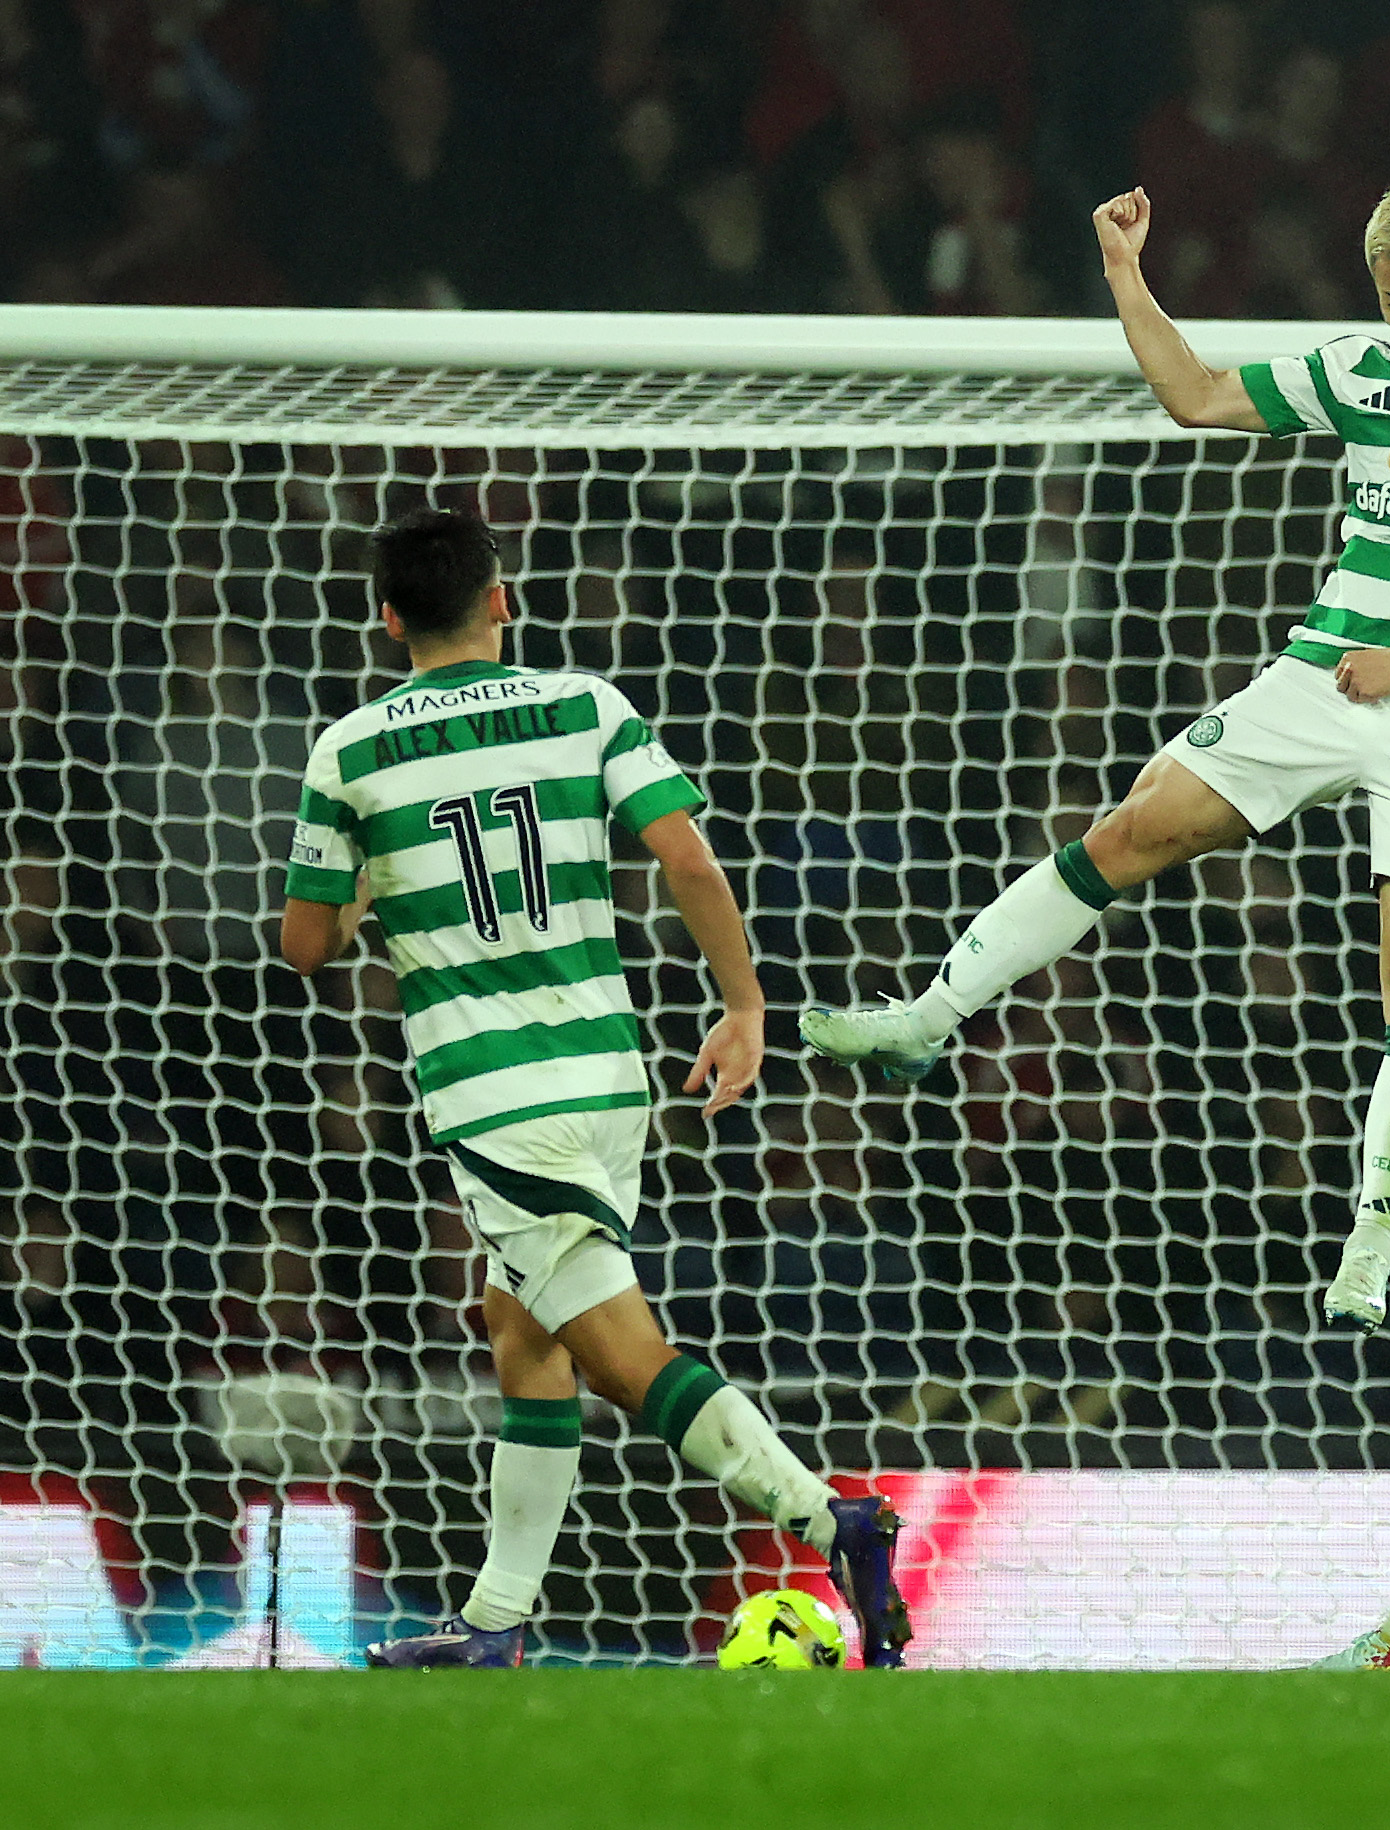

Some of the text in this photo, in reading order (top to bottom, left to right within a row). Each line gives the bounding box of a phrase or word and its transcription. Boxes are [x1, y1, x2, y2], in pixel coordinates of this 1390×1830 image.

[386, 681, 540, 722] MAGNERS
[374, 703, 567, 769] ALEX VALLE
[429, 782, 550, 944] 11
